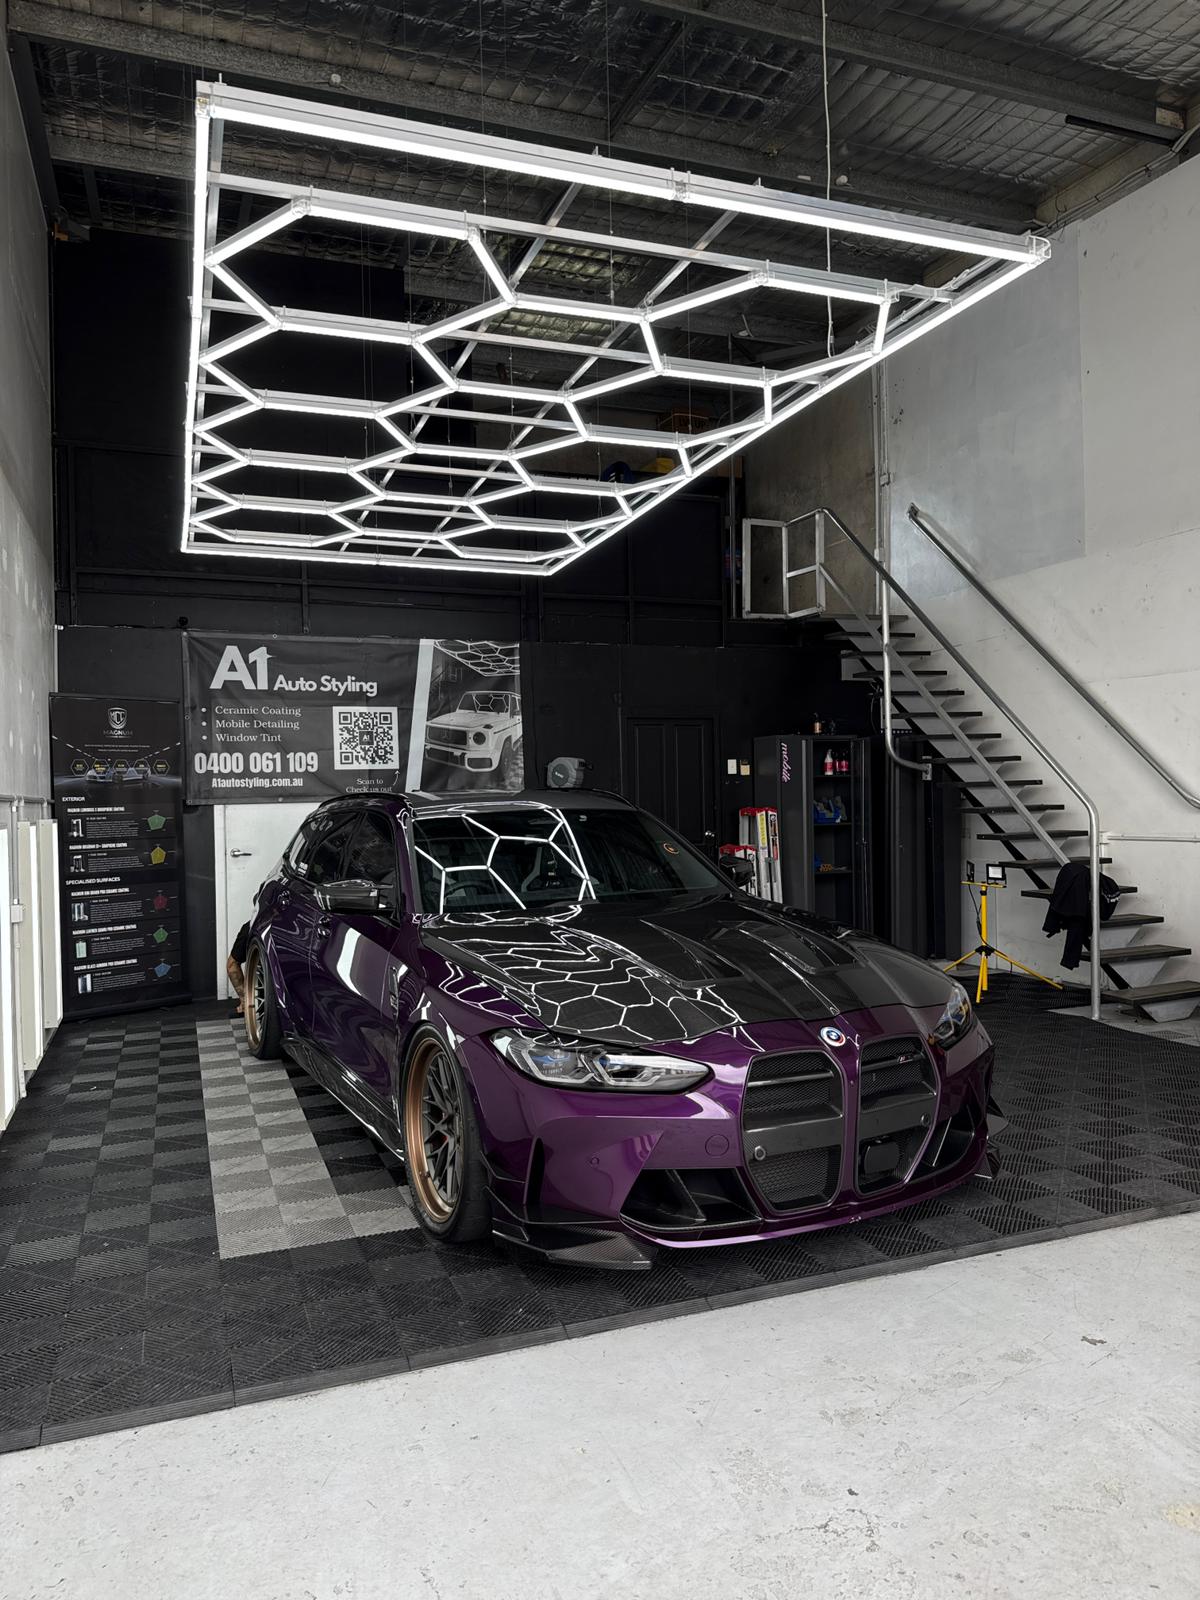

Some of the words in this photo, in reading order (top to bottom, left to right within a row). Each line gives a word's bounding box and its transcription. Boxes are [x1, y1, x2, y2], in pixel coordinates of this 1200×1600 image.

[209, 645, 273, 690] A1
[273, 674, 317, 691] Auto
[319, 675, 378, 697] Styling
[215, 705, 259, 715] Ceramic
[261, 706, 301, 717] Coating
[215, 719, 251, 728] Mobile
[253, 719, 300, 730] Detailing
[215, 733, 258, 742] Window
[260, 733, 282, 742] Tint
[194, 752, 244, 774] 0400
[249, 752, 282, 773] 061
[286, 751, 319, 773] 109
[211, 777, 304, 788] A1autostyling.com.au
